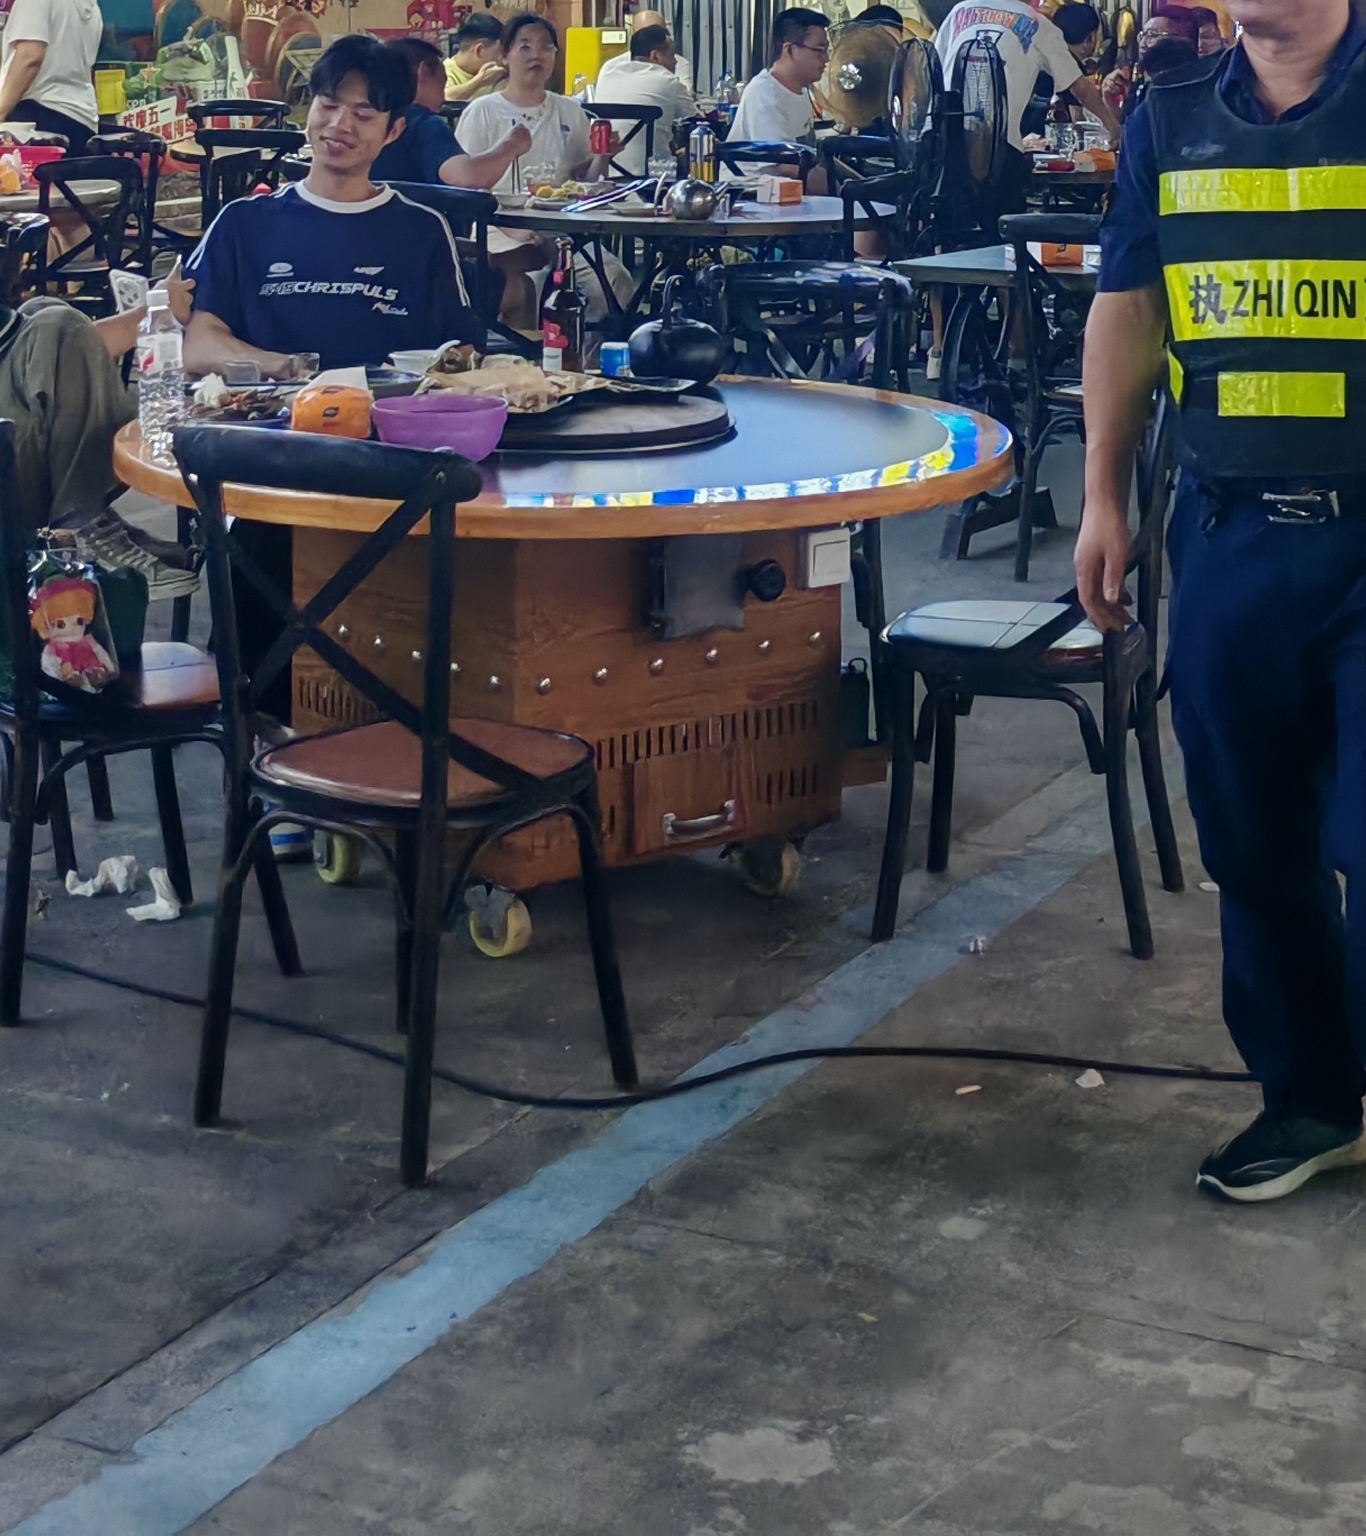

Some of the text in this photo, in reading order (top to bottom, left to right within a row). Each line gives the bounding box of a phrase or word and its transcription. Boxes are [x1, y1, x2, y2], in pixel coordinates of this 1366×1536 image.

[1189, 274, 1227, 325] 执
[1231, 279, 1284, 318] ZHI
[1294, 279, 1357, 319] QIN
